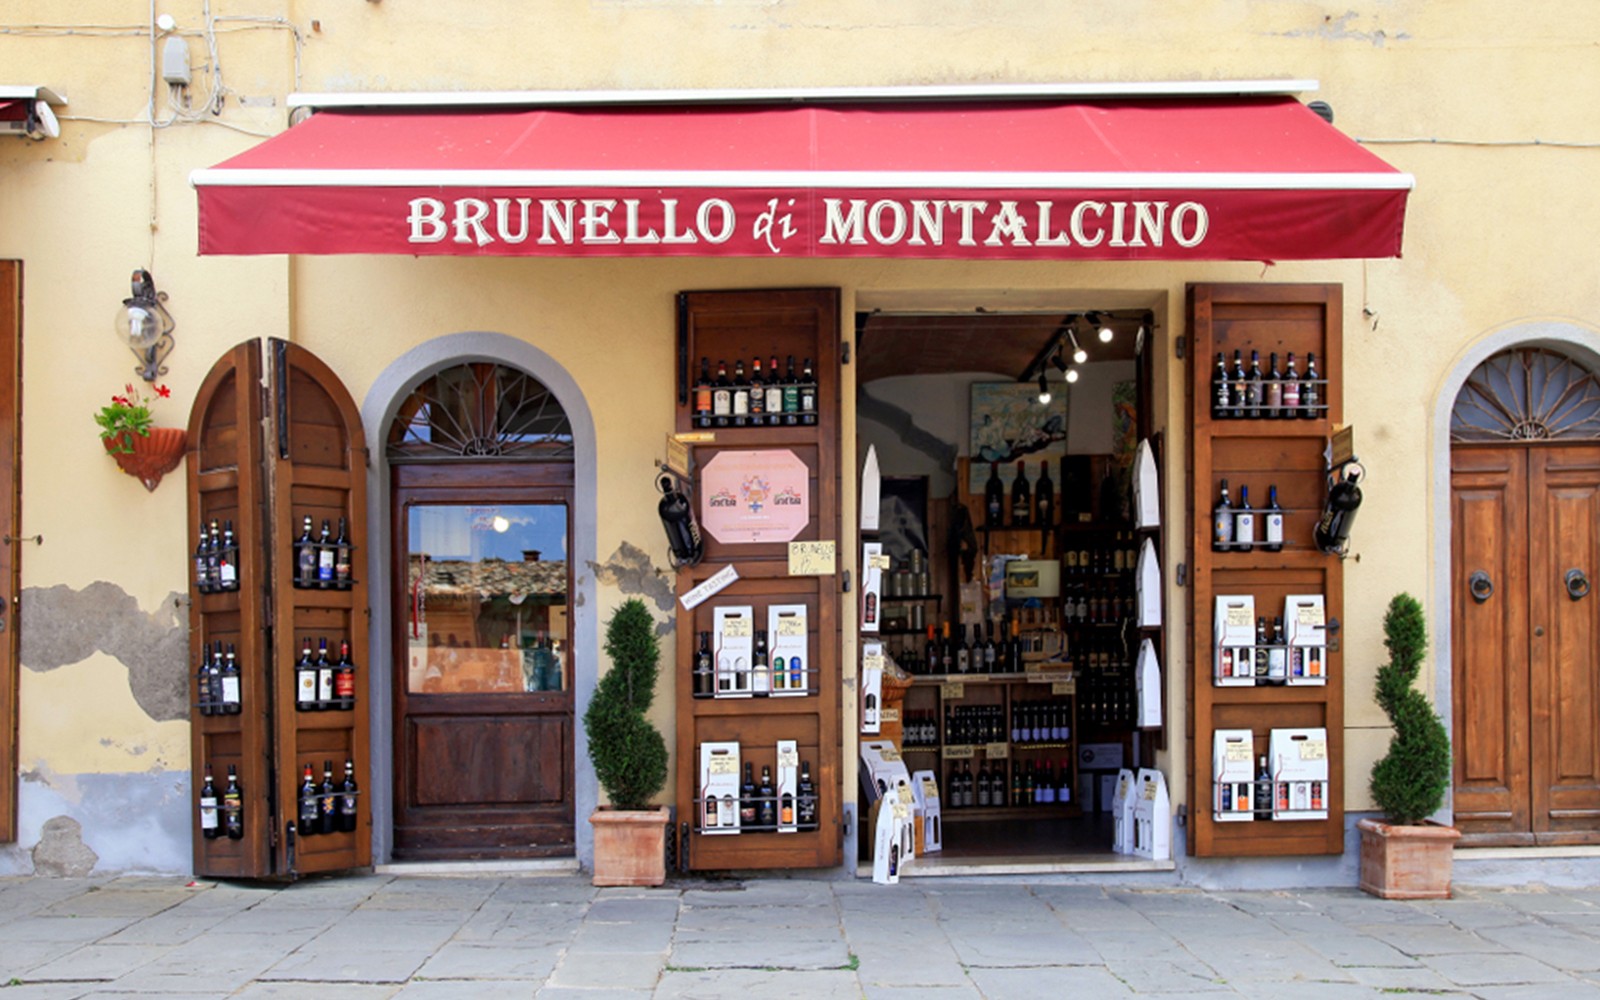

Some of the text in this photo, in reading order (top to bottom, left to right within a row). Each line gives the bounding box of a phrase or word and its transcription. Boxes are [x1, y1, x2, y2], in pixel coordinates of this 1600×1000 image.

[406, 197, 1209, 254] BRUNELLO di MONTALCINO
